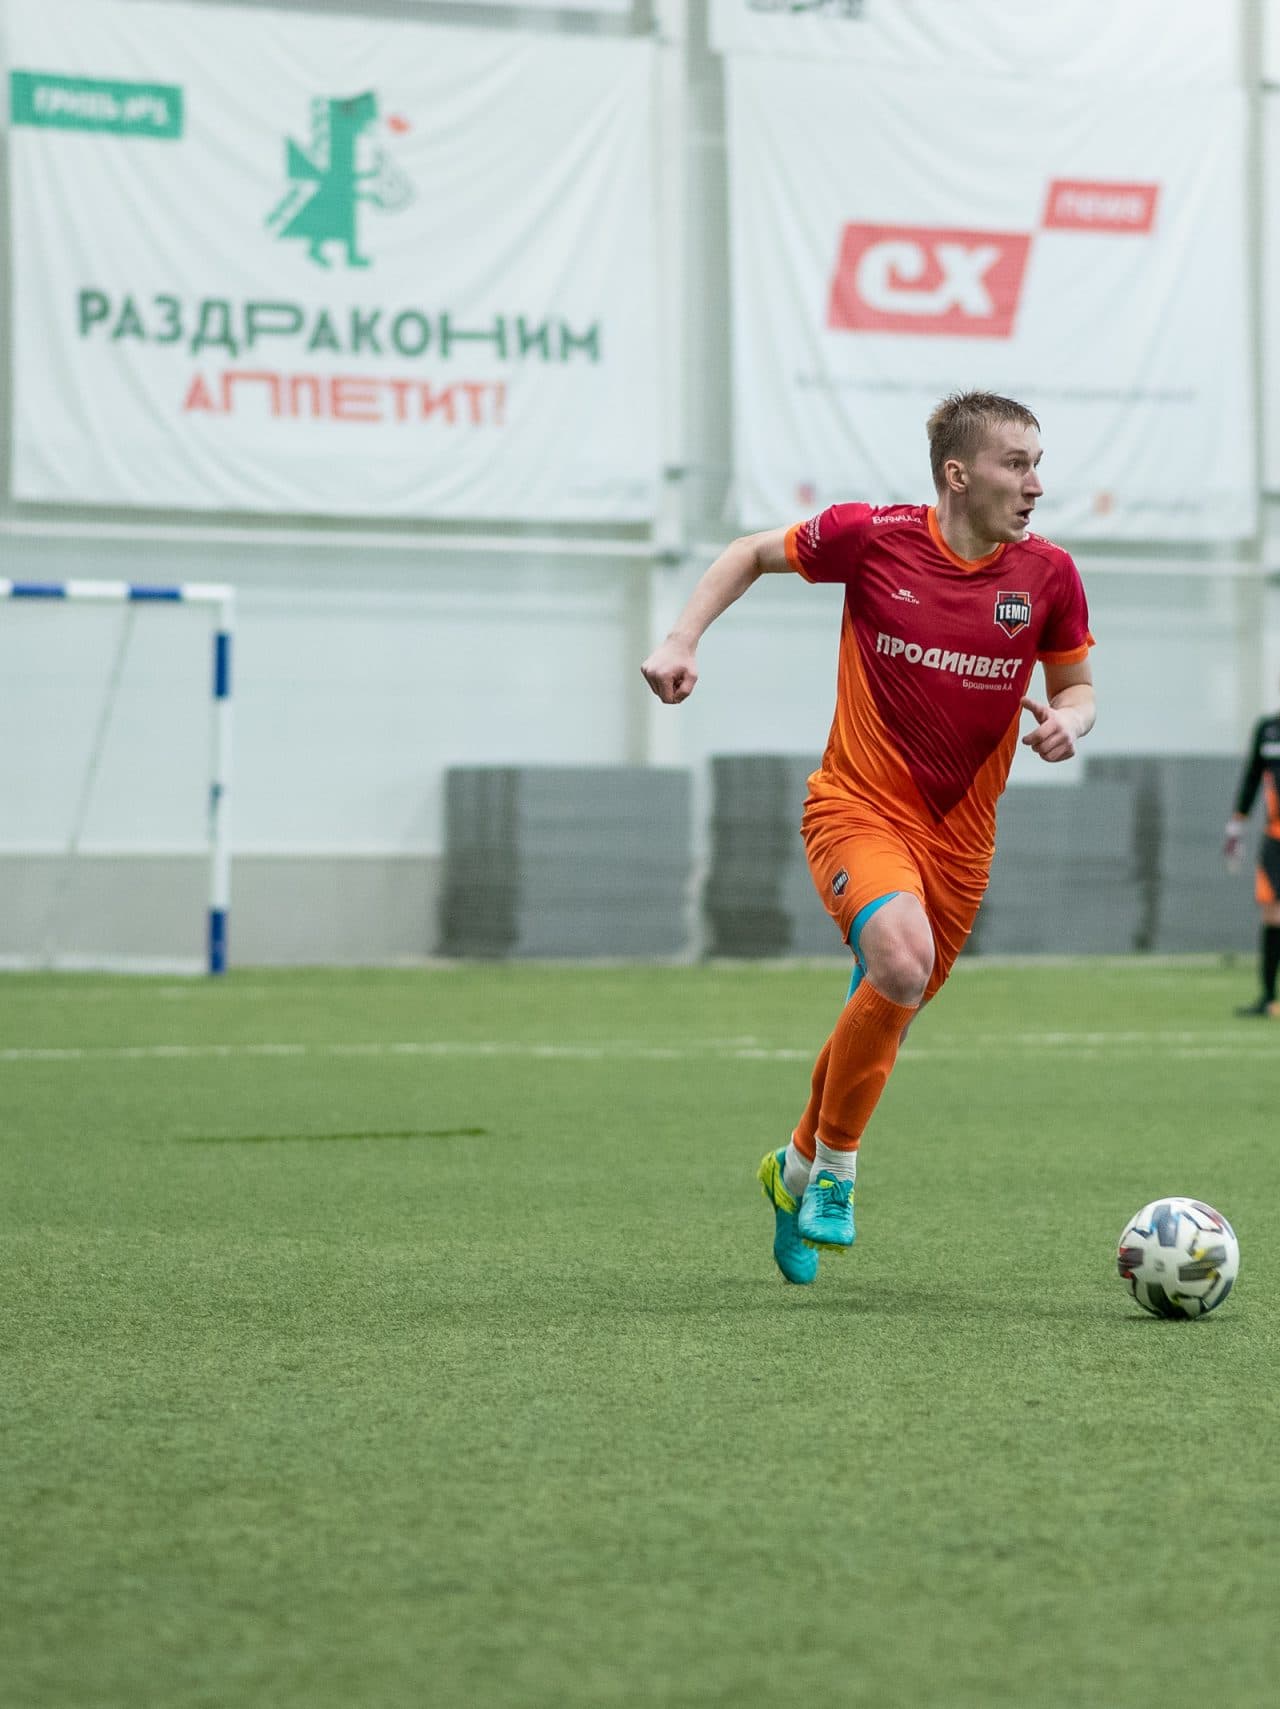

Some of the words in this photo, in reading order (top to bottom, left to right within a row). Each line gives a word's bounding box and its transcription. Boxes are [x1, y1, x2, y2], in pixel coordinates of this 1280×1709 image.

[78, 286, 602, 363] РАЗДРАКОНИМ
[183, 369, 510, 427] АППЕТИТ!
[998, 603, 1028, 621] ТЕМП
[876, 632, 1022, 680] ПРОДИНВЕСТ
